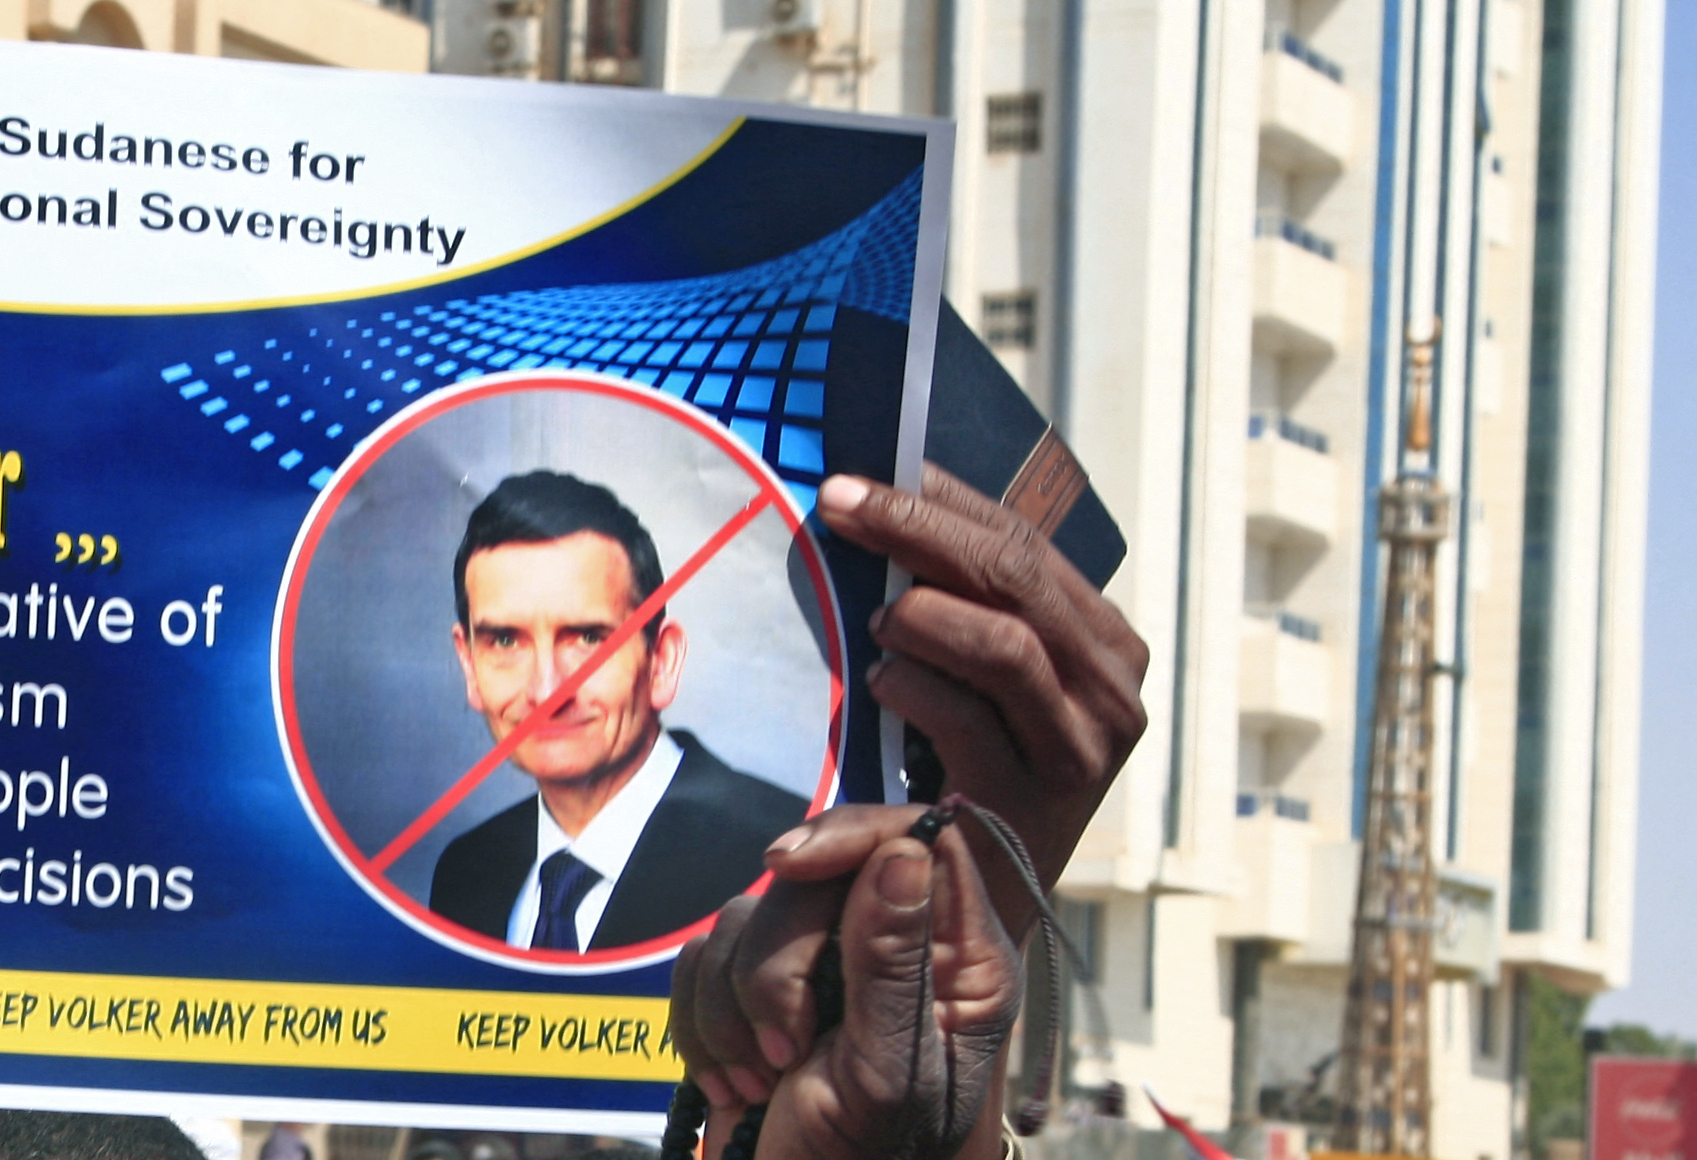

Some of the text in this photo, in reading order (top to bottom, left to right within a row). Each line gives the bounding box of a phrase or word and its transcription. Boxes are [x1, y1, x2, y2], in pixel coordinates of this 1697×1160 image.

[289, 141, 365, 183] for
[139, 191, 467, 266] Sovereignty
[159, 584, 225, 649] of
[48, 996, 162, 1039] VOLKER
[169, 999, 255, 1042] AWAY
[263, 1004, 343, 1046] FROM
[351, 1009, 388, 1046] US
[456, 1012, 532, 1053] KEEP
[539, 1017, 651, 1060] VOLKER
